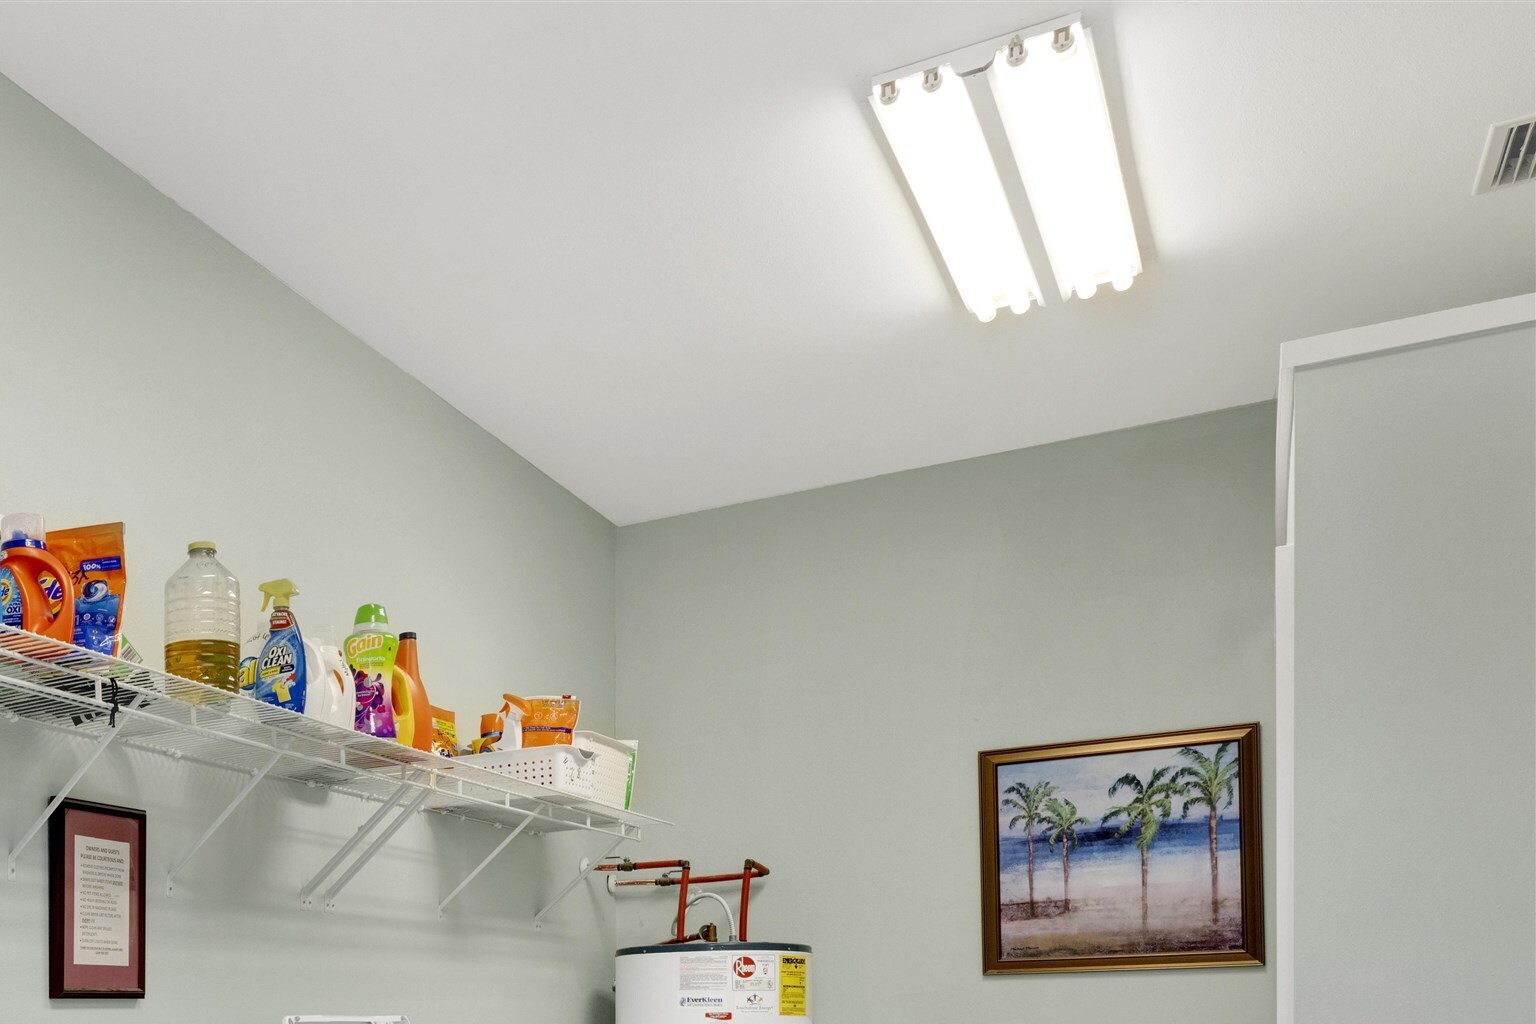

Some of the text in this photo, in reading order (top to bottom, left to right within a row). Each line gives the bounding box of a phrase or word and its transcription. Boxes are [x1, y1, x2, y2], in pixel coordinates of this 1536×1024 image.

[6, 606, 20, 614] OXI
[268, 646, 286, 656] OXI
[346, 634, 383, 658] Gain
[262, 653, 293, 670] CLEAN
[736, 957, 755, 976] Rheem
